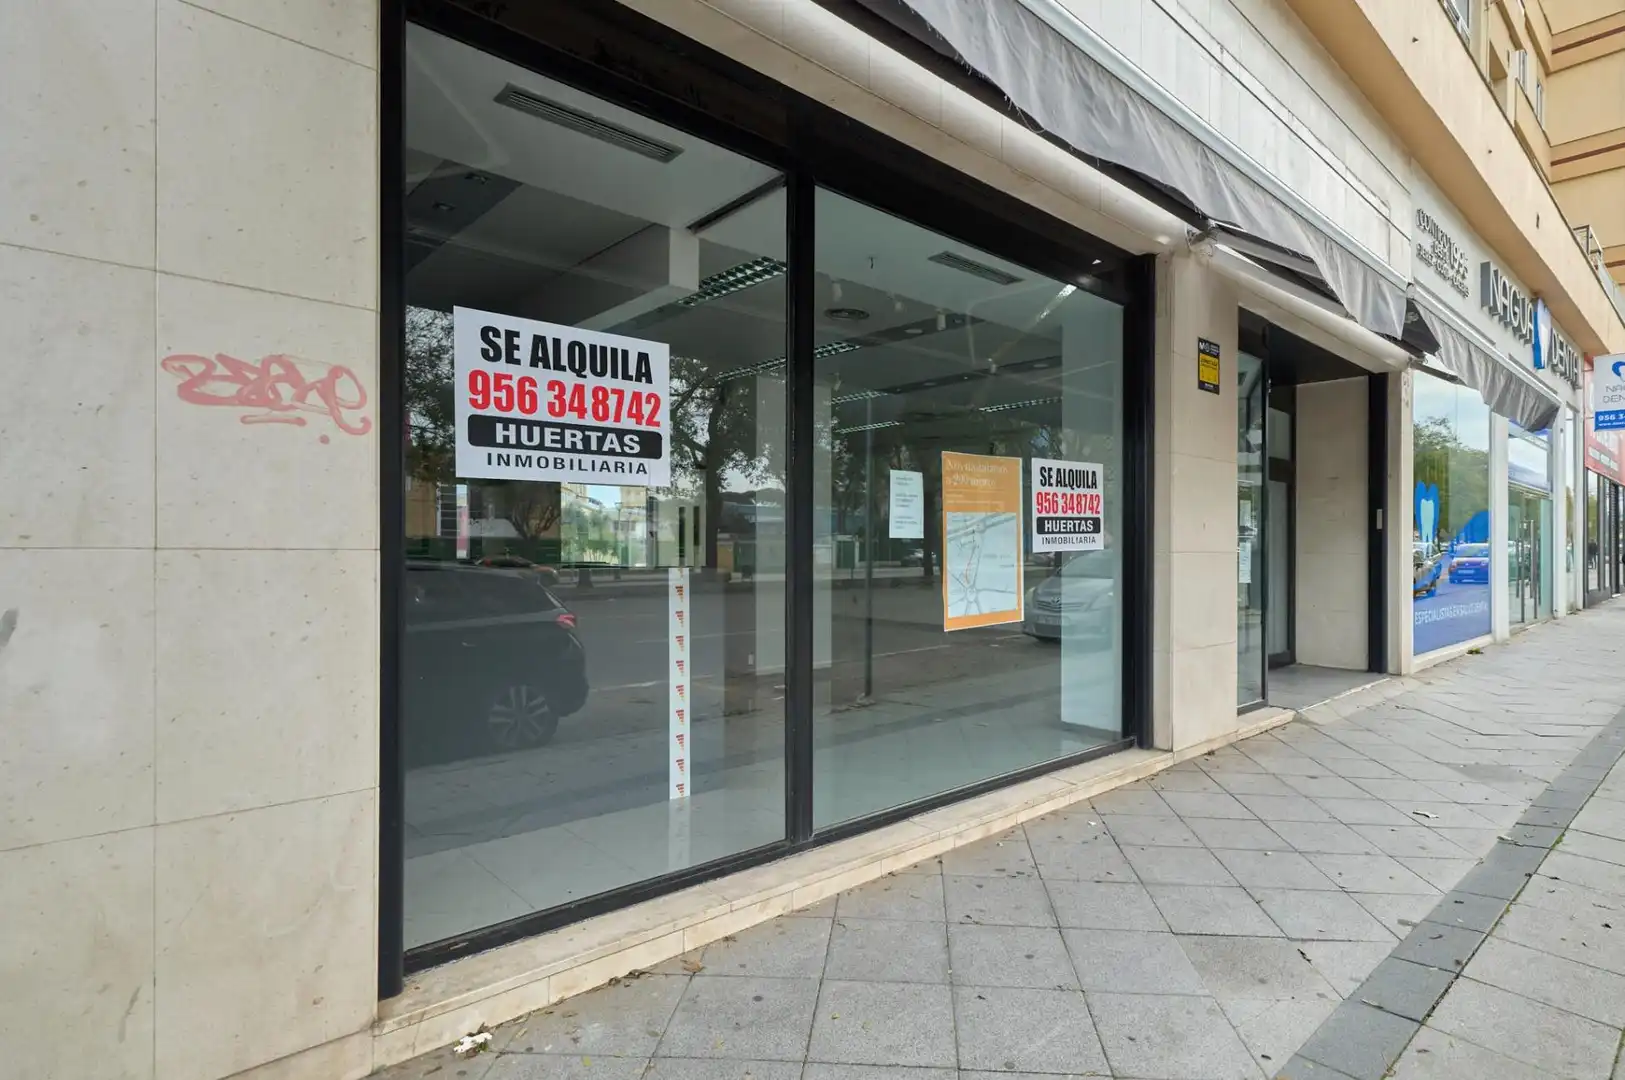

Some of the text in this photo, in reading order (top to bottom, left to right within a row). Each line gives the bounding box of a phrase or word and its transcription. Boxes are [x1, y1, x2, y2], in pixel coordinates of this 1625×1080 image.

[1480, 261, 1534, 345] NAGUA
[480, 325, 653, 384] SE ALQUILA
[468, 369, 661, 428] 956 348742
[495, 422, 641, 454] HUERTAS
[487, 452, 648, 475] INMOBILIARIA
[1040, 466, 1097, 490] SE ALQUILA
[1036, 492, 1100, 515] 956 348742
[1044, 520, 1093, 533] HUERTAS
[1042, 536, 1096, 545] INMOBILIARIA
